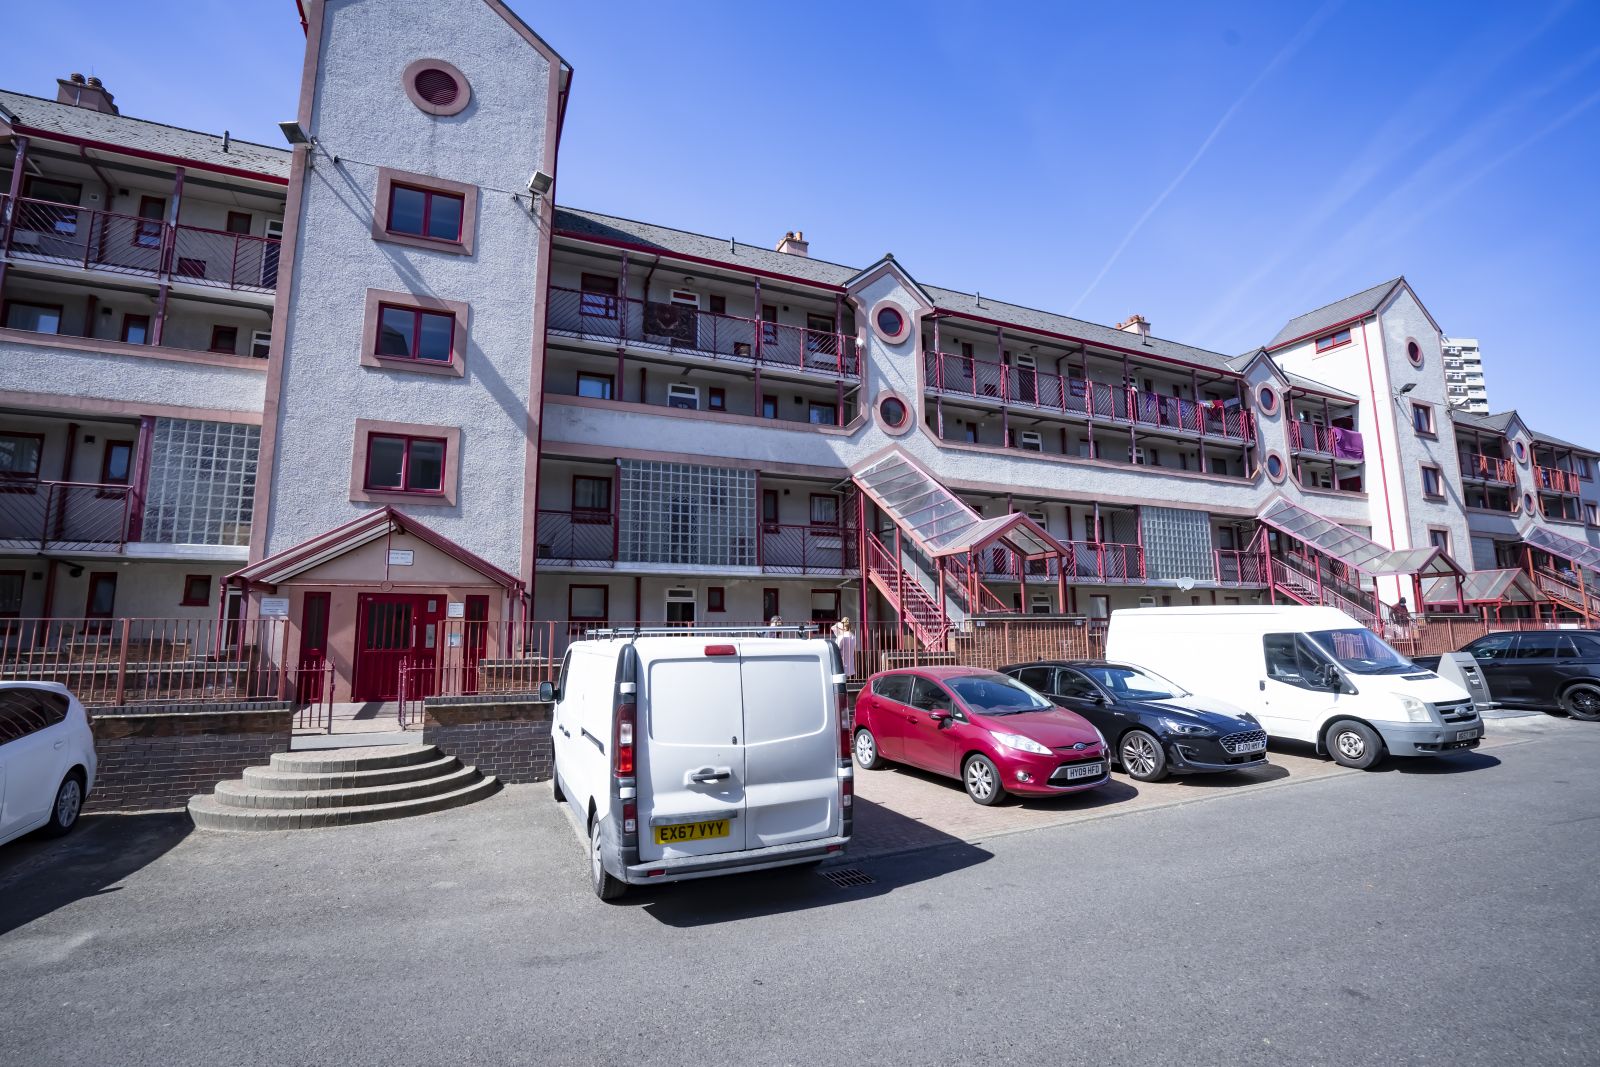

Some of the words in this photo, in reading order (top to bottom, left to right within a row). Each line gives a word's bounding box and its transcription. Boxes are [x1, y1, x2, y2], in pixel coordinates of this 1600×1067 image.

[1070, 767, 1087, 778] HY09
[1088, 765, 1100, 775] HFD
[660, 824, 695, 841] EX67
[699, 821, 723, 837] VYY
